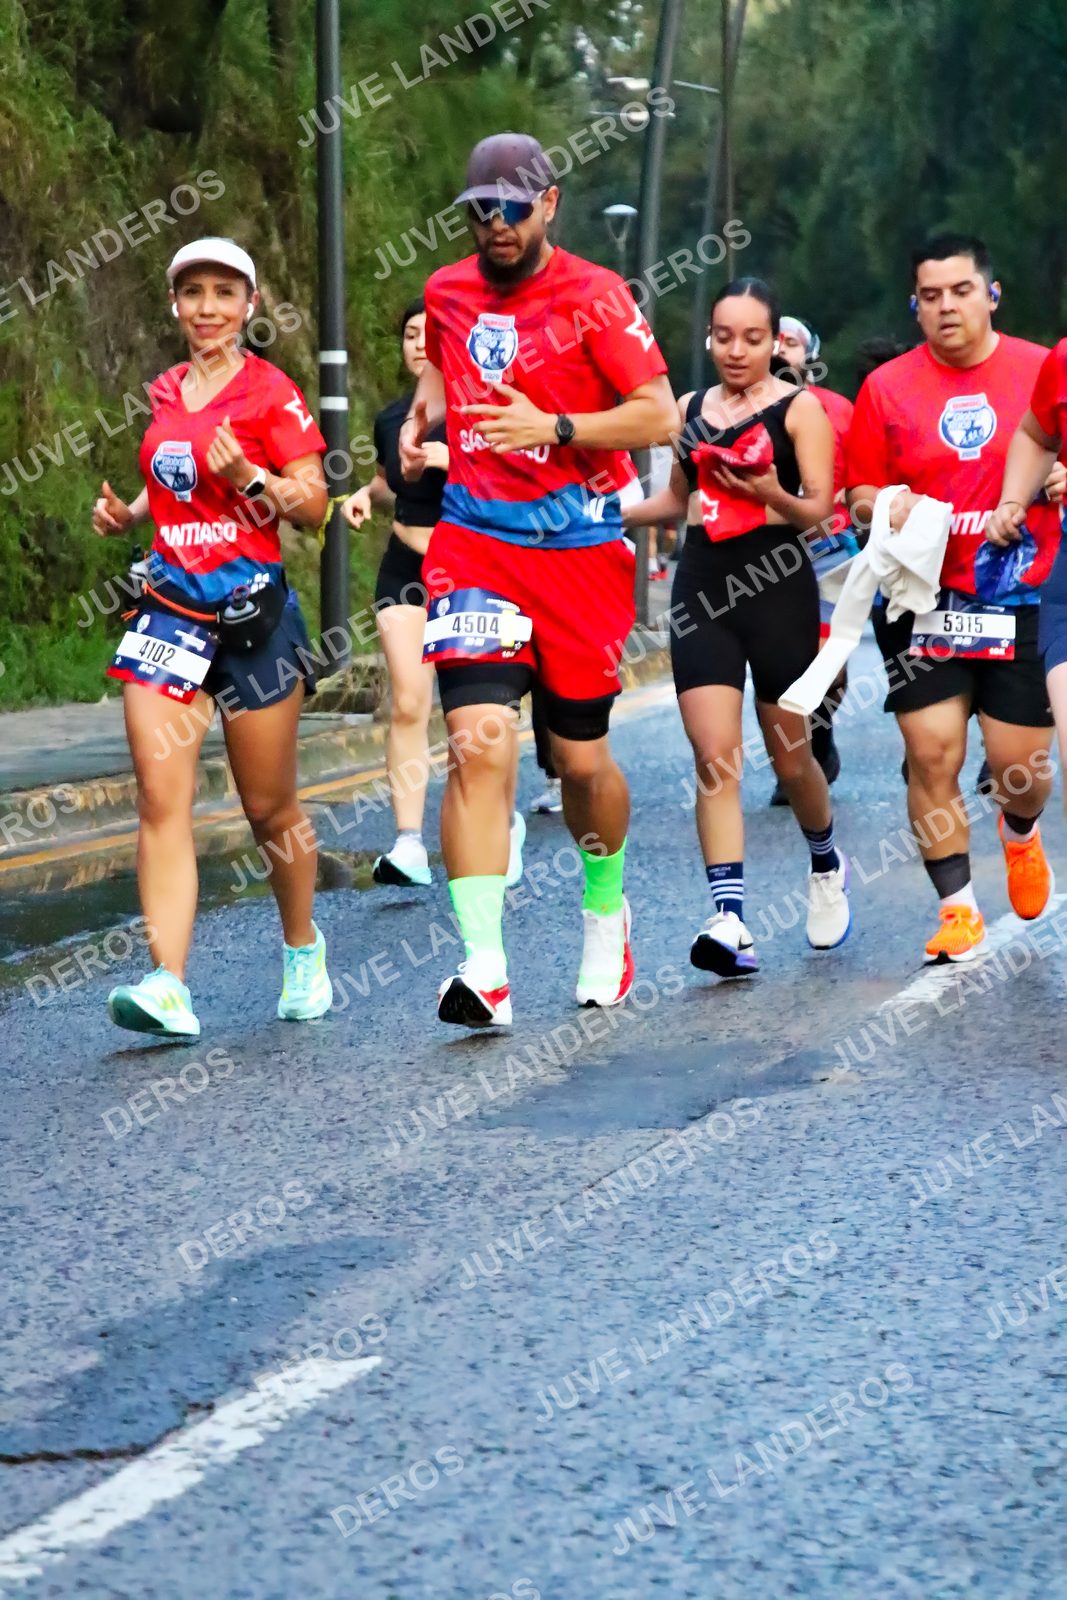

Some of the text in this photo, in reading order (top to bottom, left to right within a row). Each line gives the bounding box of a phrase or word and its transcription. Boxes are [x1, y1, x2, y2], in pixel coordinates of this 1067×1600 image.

[452, 615, 500, 634] 4504
[944, 614, 983, 633] 5315
[139, 640, 177, 667] 4102
